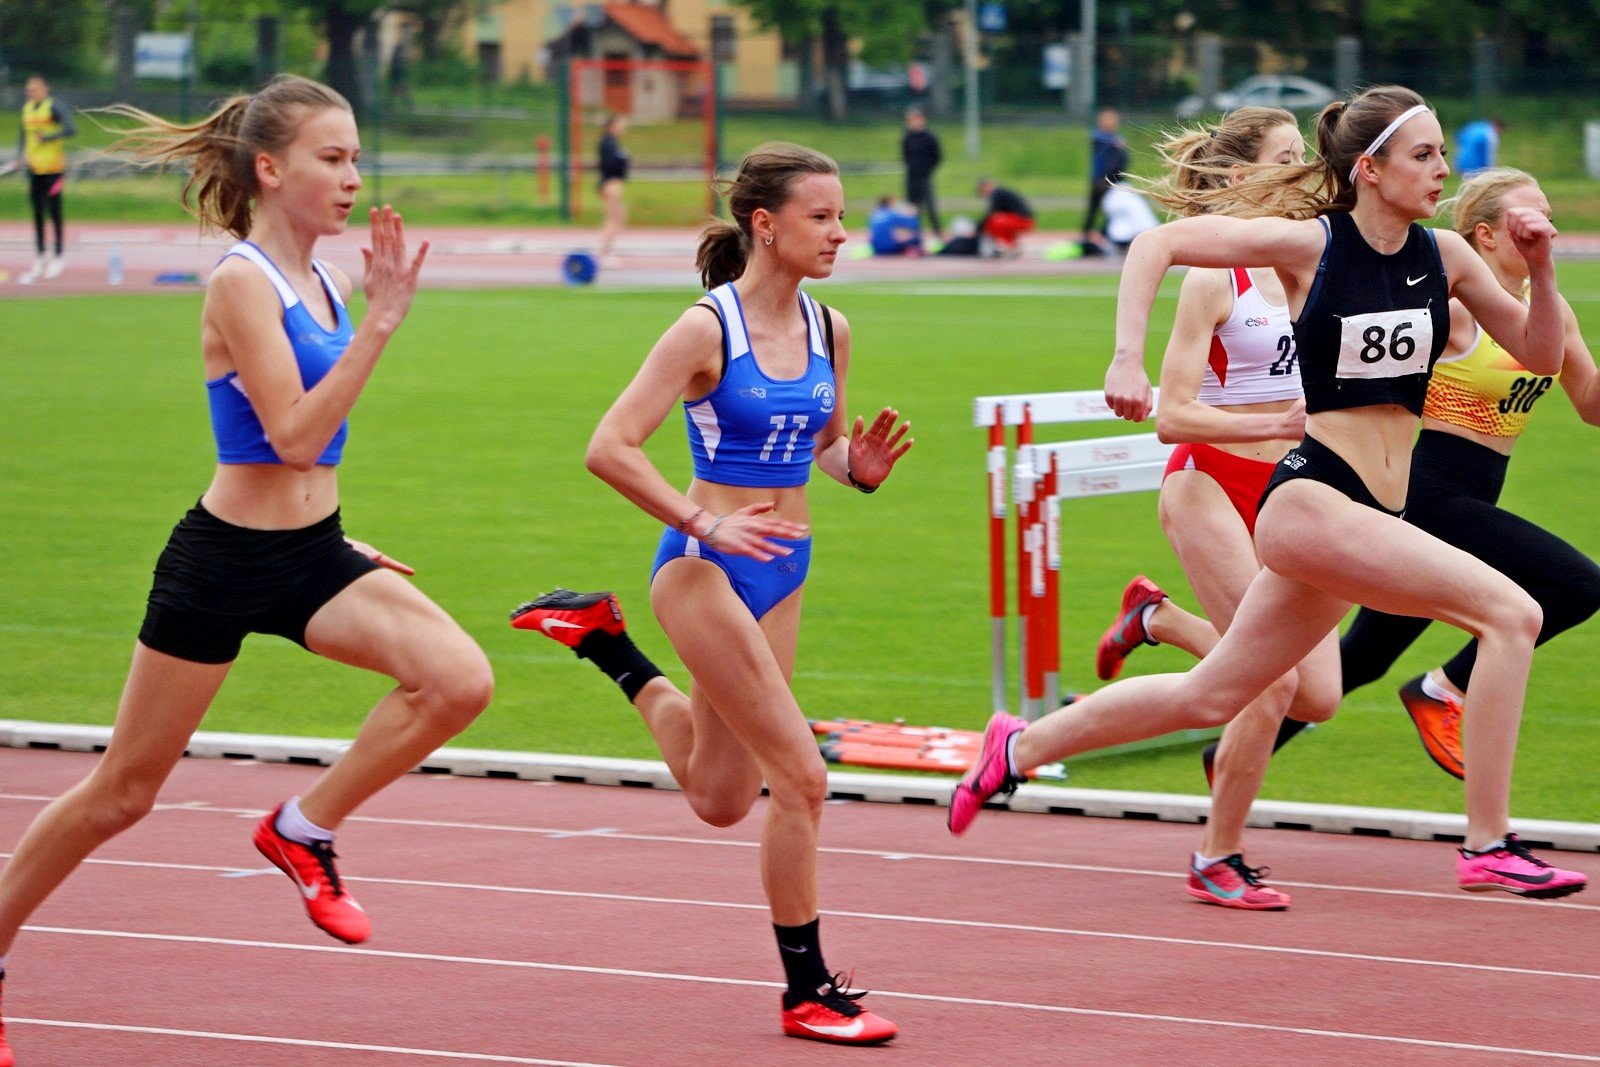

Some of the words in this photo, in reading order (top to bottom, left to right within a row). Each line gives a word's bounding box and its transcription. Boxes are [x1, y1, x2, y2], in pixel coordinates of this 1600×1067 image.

[1245, 316, 1269, 328] esa
[1360, 321, 1415, 364] 86
[739, 387, 767, 399] esa
[1498, 376, 1553, 414] 316
[760, 415, 809, 462] 77
